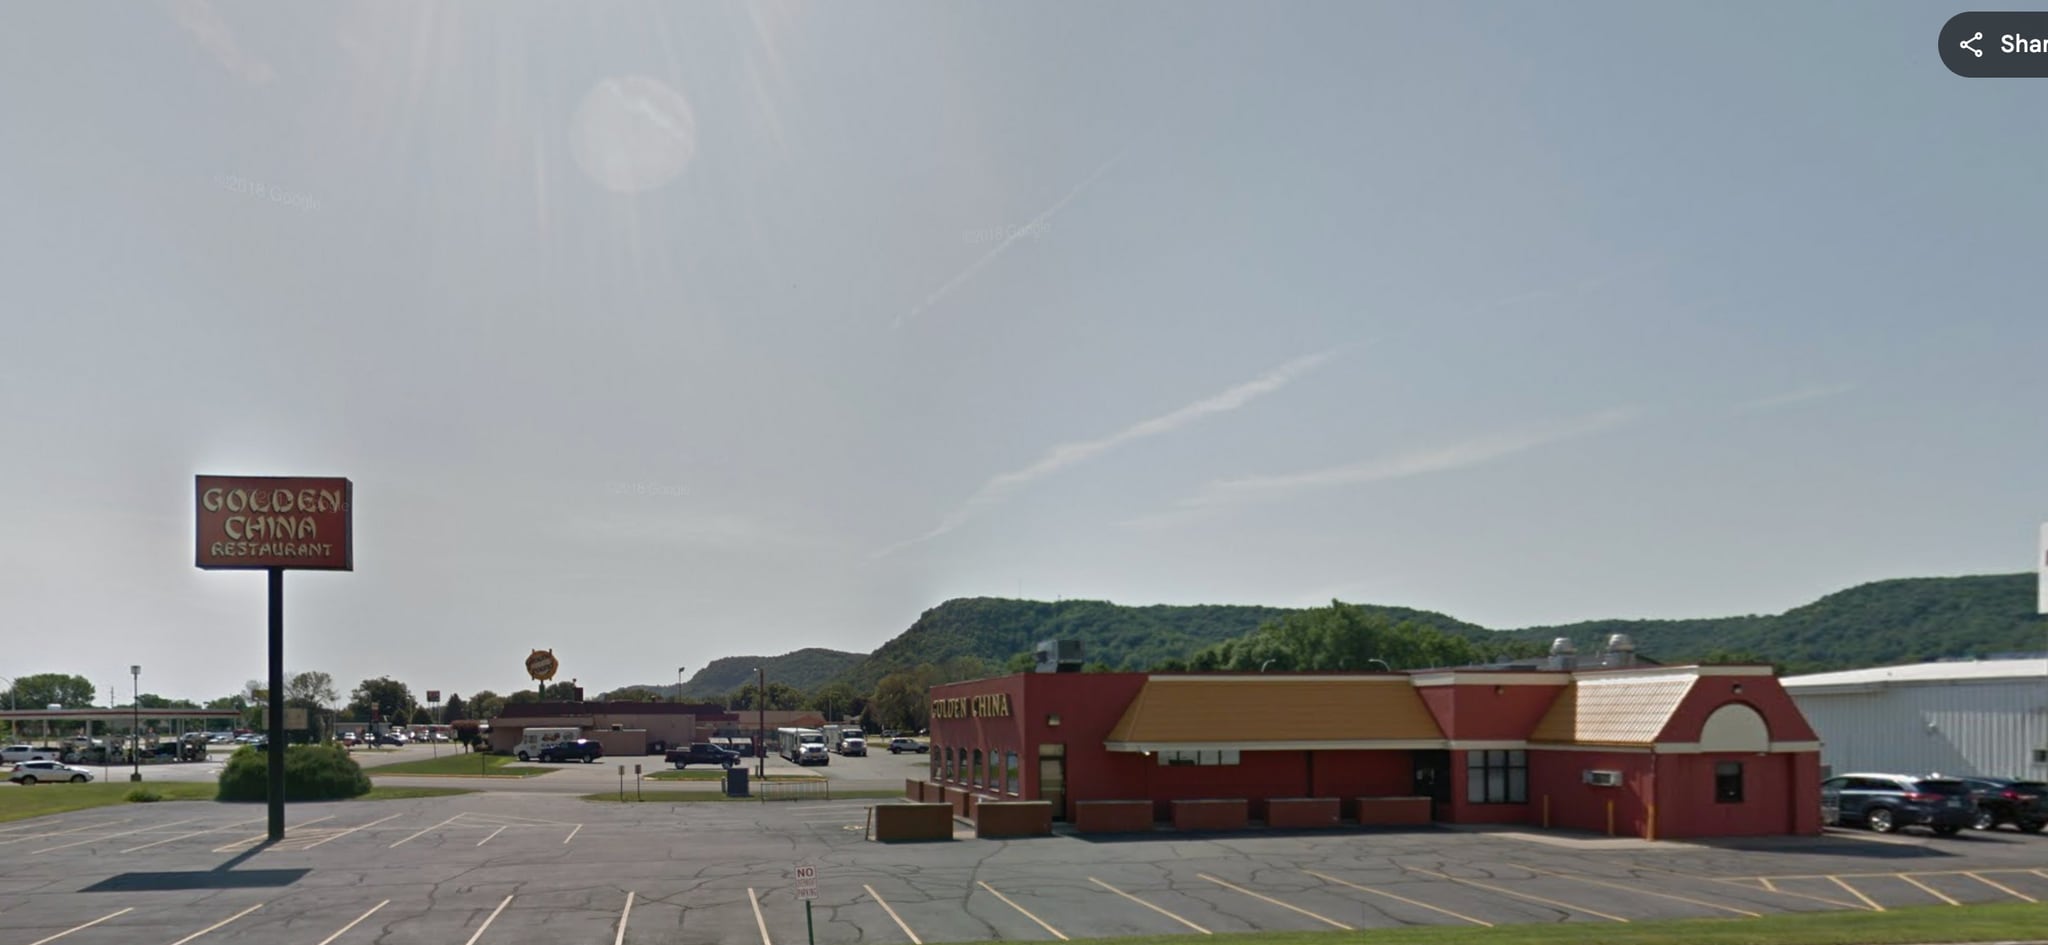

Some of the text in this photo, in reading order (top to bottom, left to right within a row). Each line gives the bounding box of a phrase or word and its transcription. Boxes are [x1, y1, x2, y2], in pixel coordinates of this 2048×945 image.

[203, 488, 341, 512] GOLDEN
[224, 515, 316, 540] CHINA
[211, 542, 333, 556] RESTAURANT
[931, 693, 1009, 719] GOLDEN CHINA
[797, 868, 813, 877] NO
